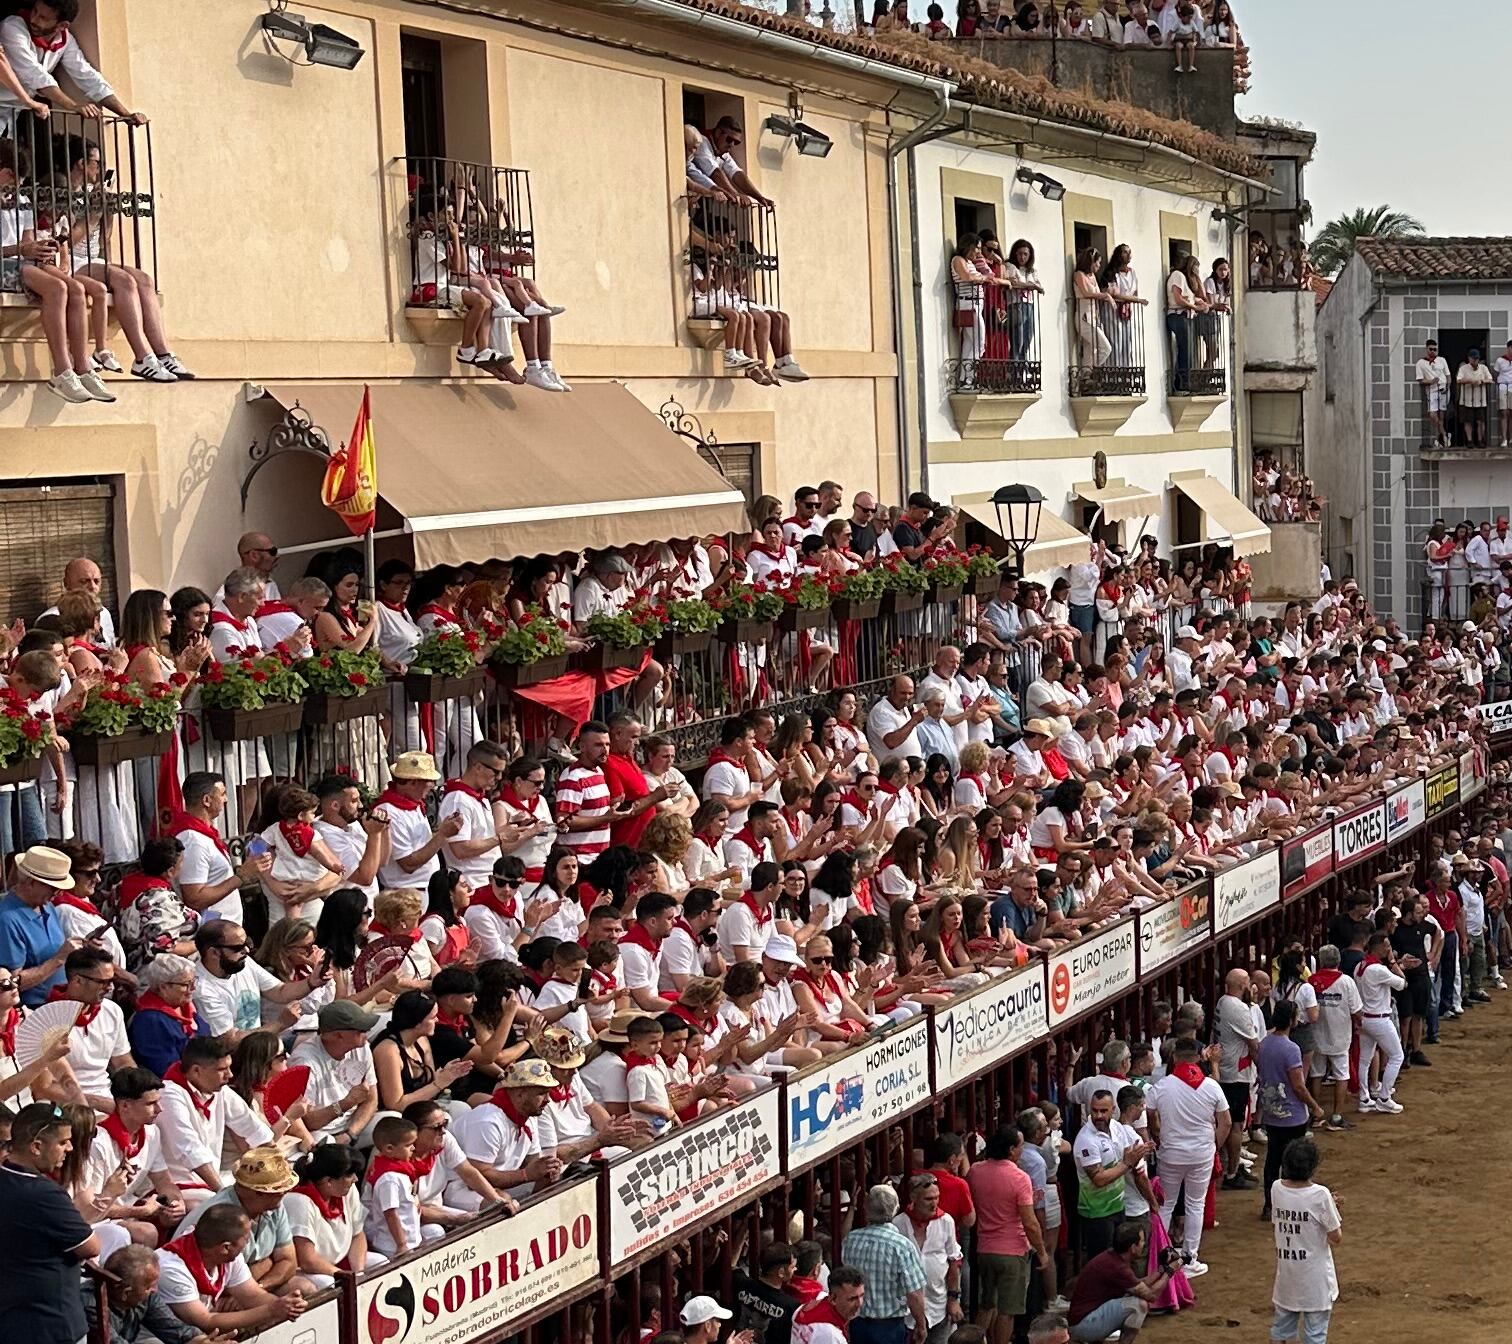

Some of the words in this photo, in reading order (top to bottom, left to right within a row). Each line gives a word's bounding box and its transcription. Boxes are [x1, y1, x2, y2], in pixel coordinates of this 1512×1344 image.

[1339, 809, 1382, 857] TORRES
[866, 1027, 927, 1073] HORMIGONES
[871, 1102, 888, 1119] 927
[891, 1095, 903, 1110] 50
[905, 1089, 914, 1103] 01
[640, 1126, 755, 1208] SOLINCO
[420, 1245, 477, 1282] Maderas
[1285, 1236, 1291, 1248] Y
[421, 1213, 593, 1329] SOBRADO
